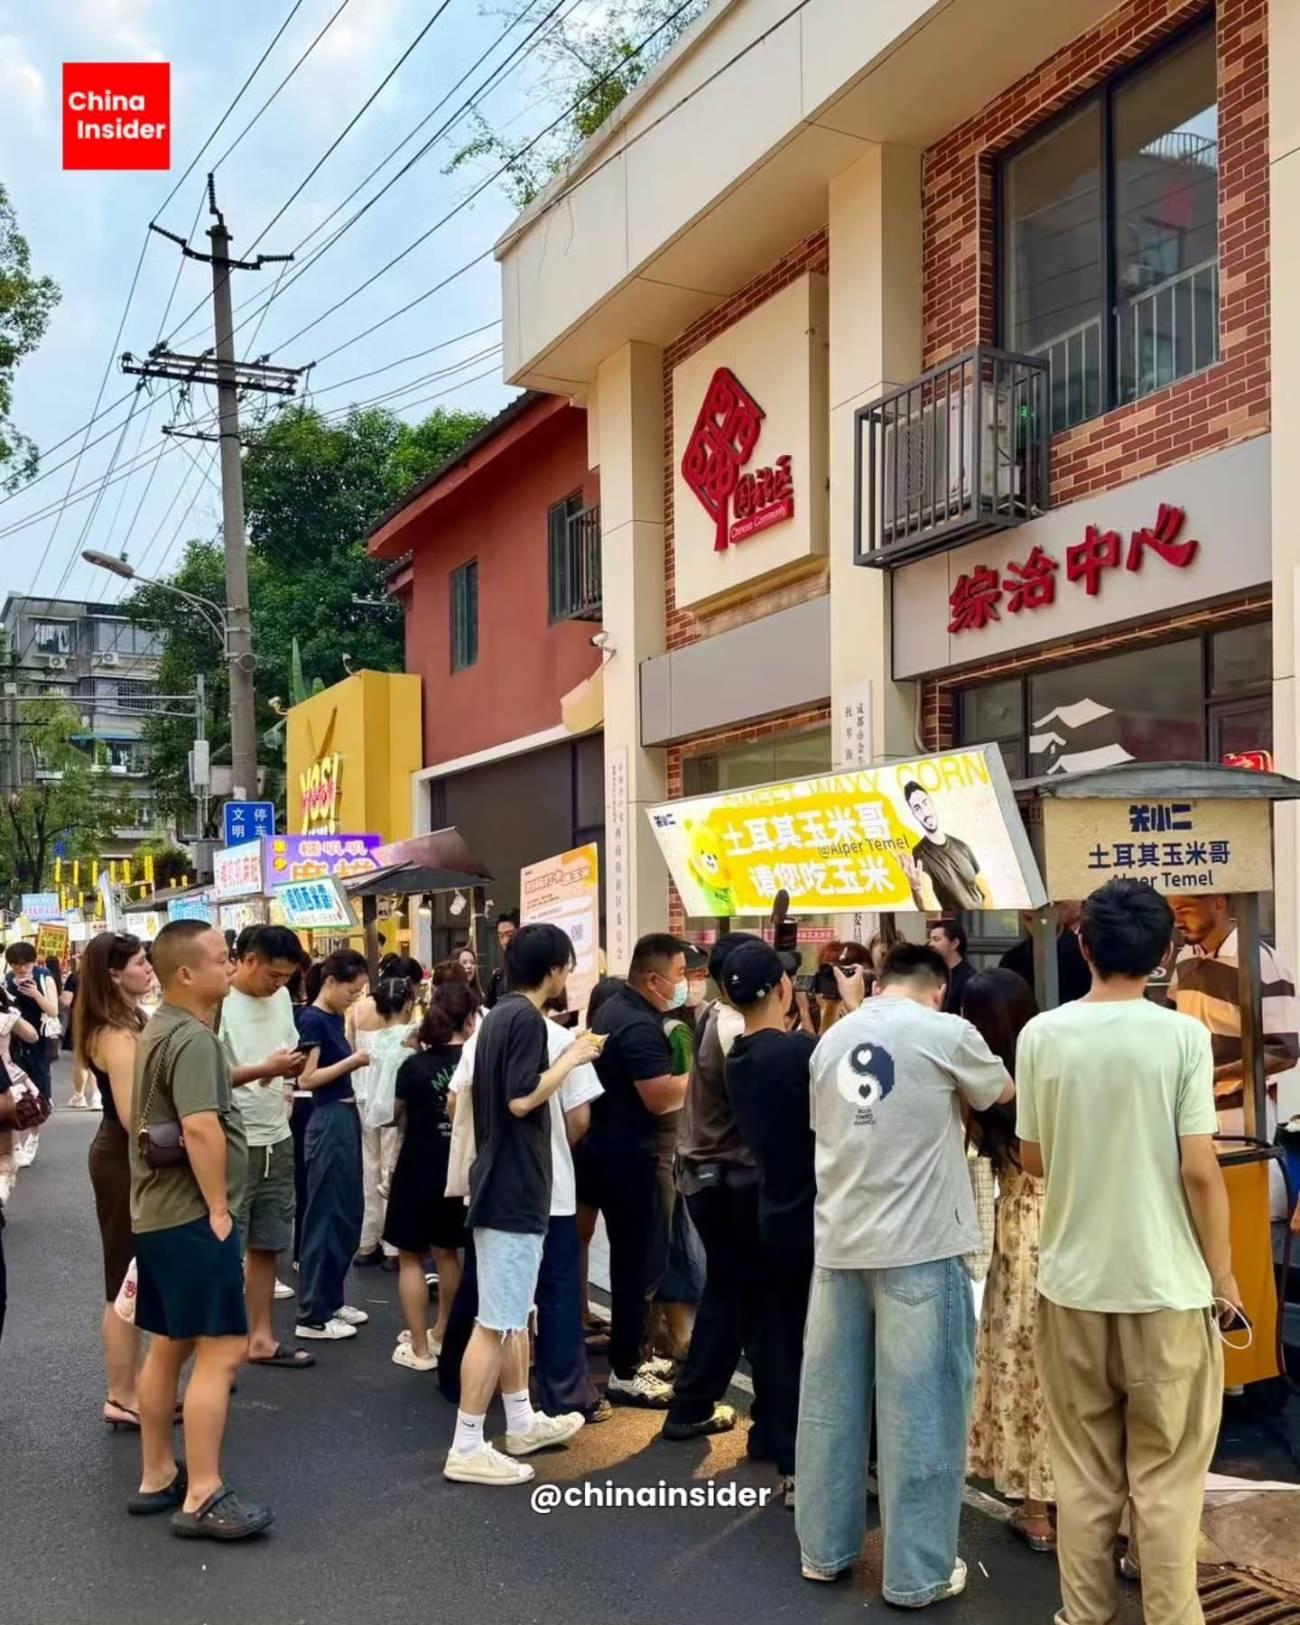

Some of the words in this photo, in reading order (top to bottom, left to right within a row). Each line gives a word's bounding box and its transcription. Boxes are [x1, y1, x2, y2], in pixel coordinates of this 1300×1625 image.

[947, 503, 1199, 633] 综治中心
[896, 751, 990, 792] CORN
[723, 800, 891, 857] 土耳其玉米哥
[818, 840, 864, 860] @Alper
[865, 833, 910, 852] Temel
[1088, 841, 1231, 869] 土耳其玉米哥
[1161, 869, 1214, 888] Temel
